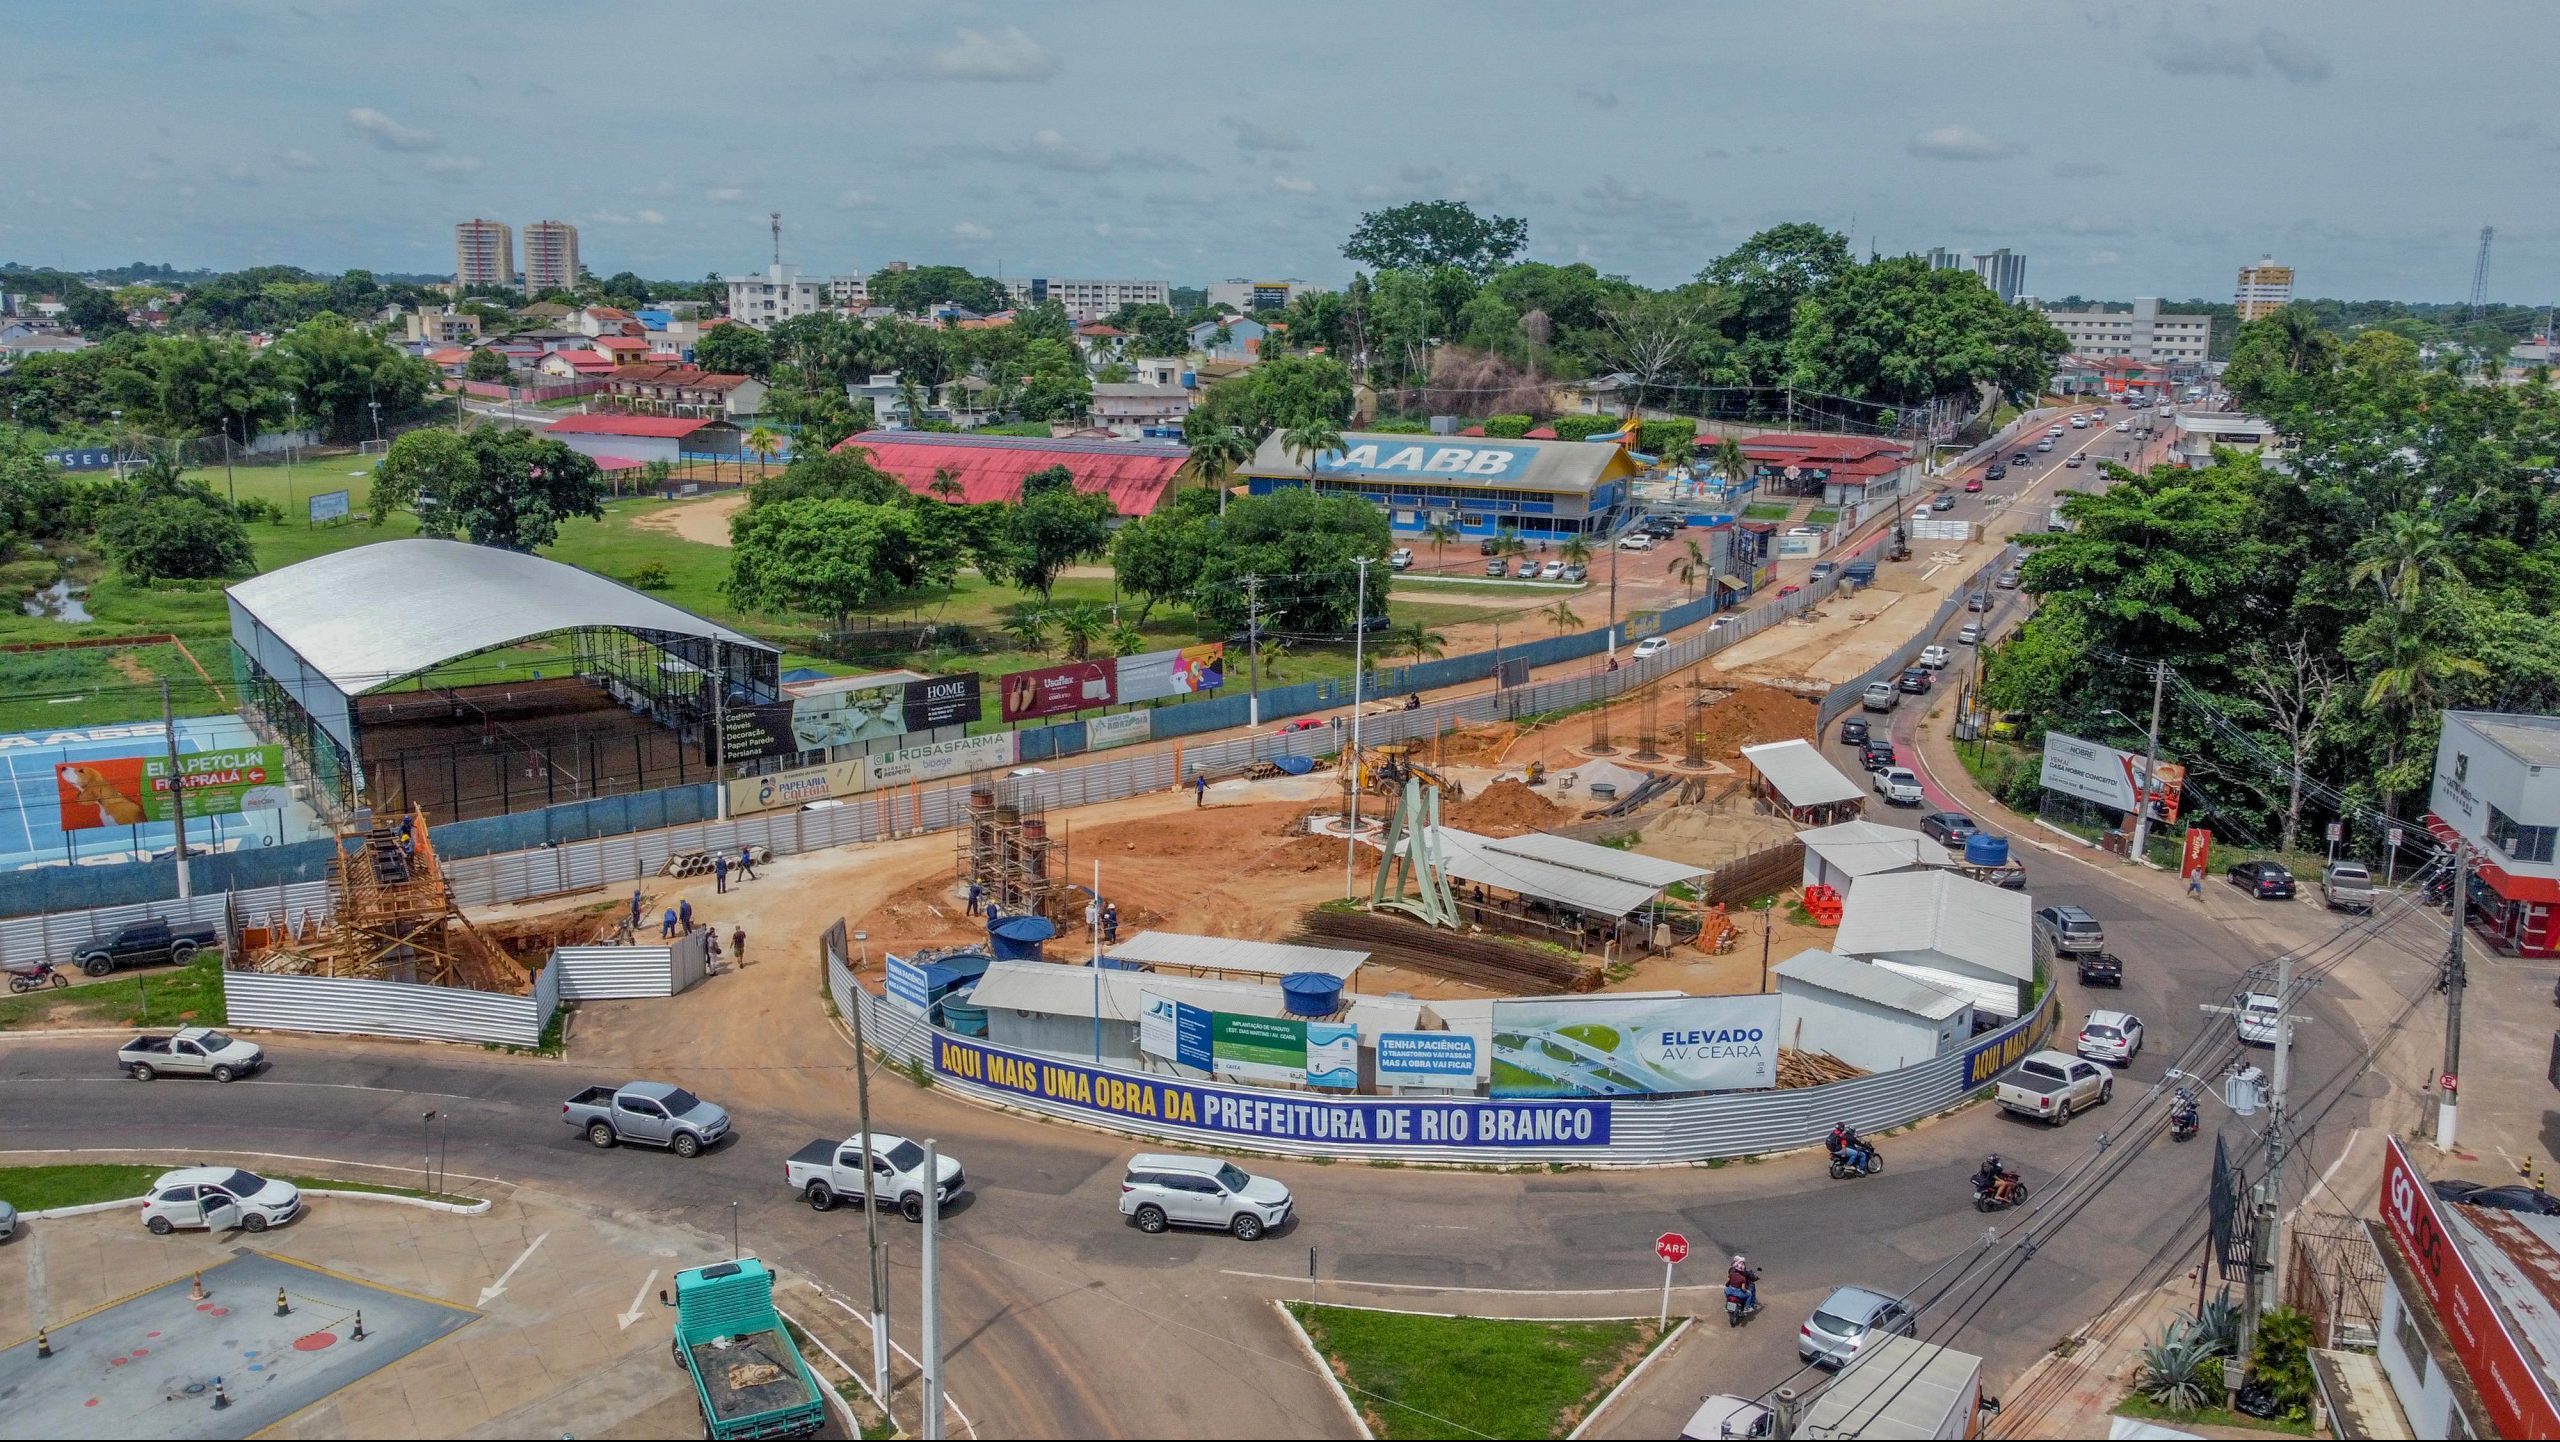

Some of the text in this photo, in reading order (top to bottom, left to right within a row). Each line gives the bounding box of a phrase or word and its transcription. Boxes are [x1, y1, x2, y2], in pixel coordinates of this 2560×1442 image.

[1330, 445, 1514, 475] AABB
[927, 681, 965, 698] HOME
[726, 722, 751, 731] Móveis
[727, 729, 765, 740] Decoração
[727, 736, 775, 751] Papel Parede
[899, 734, 1005, 761] ROSASFARMA
[2069, 745, 2093, 758] NOBRE
[188, 751, 263, 771] PETCLIN
[727, 748, 762, 759] Persianas
[2050, 755, 2062, 763] VEM
[191, 773, 219, 787] PRA
[221, 769, 241, 784] LÁ
[2049, 762, 2064, 772] CASA
[2065, 766, 2085, 777] NOBRE
[2085, 771, 2118, 786] CONCEITO!
[779, 776, 826, 792] PAPELARIA
[783, 784, 831, 800] COLEGIAL
[1232, 1021, 1262, 1029] IMPLANTAÇÃO
[1249, 1029, 1270, 1037] MARTINS
[1382, 1039, 1471, 1050] TENHA PACIÊNCIA
[1662, 1028, 1763, 1045] ELEVADO
[1661, 1042, 1761, 1060] AV. CEARÁ
[1971, 1042, 2001, 1082] AQUI
[2002, 1026, 2029, 1067] MAIS
[1382, 1059, 1400, 1067] MAS
[1408, 1060, 1432, 1068] OBRA
[1448, 1061, 1472, 1069] FICAR
[942, 1042, 1592, 1141] AQUI MAIS UMA OBRA DA PREFEITURA DE RIO BRANCO
[1658, 1241, 1687, 1254] PARE
